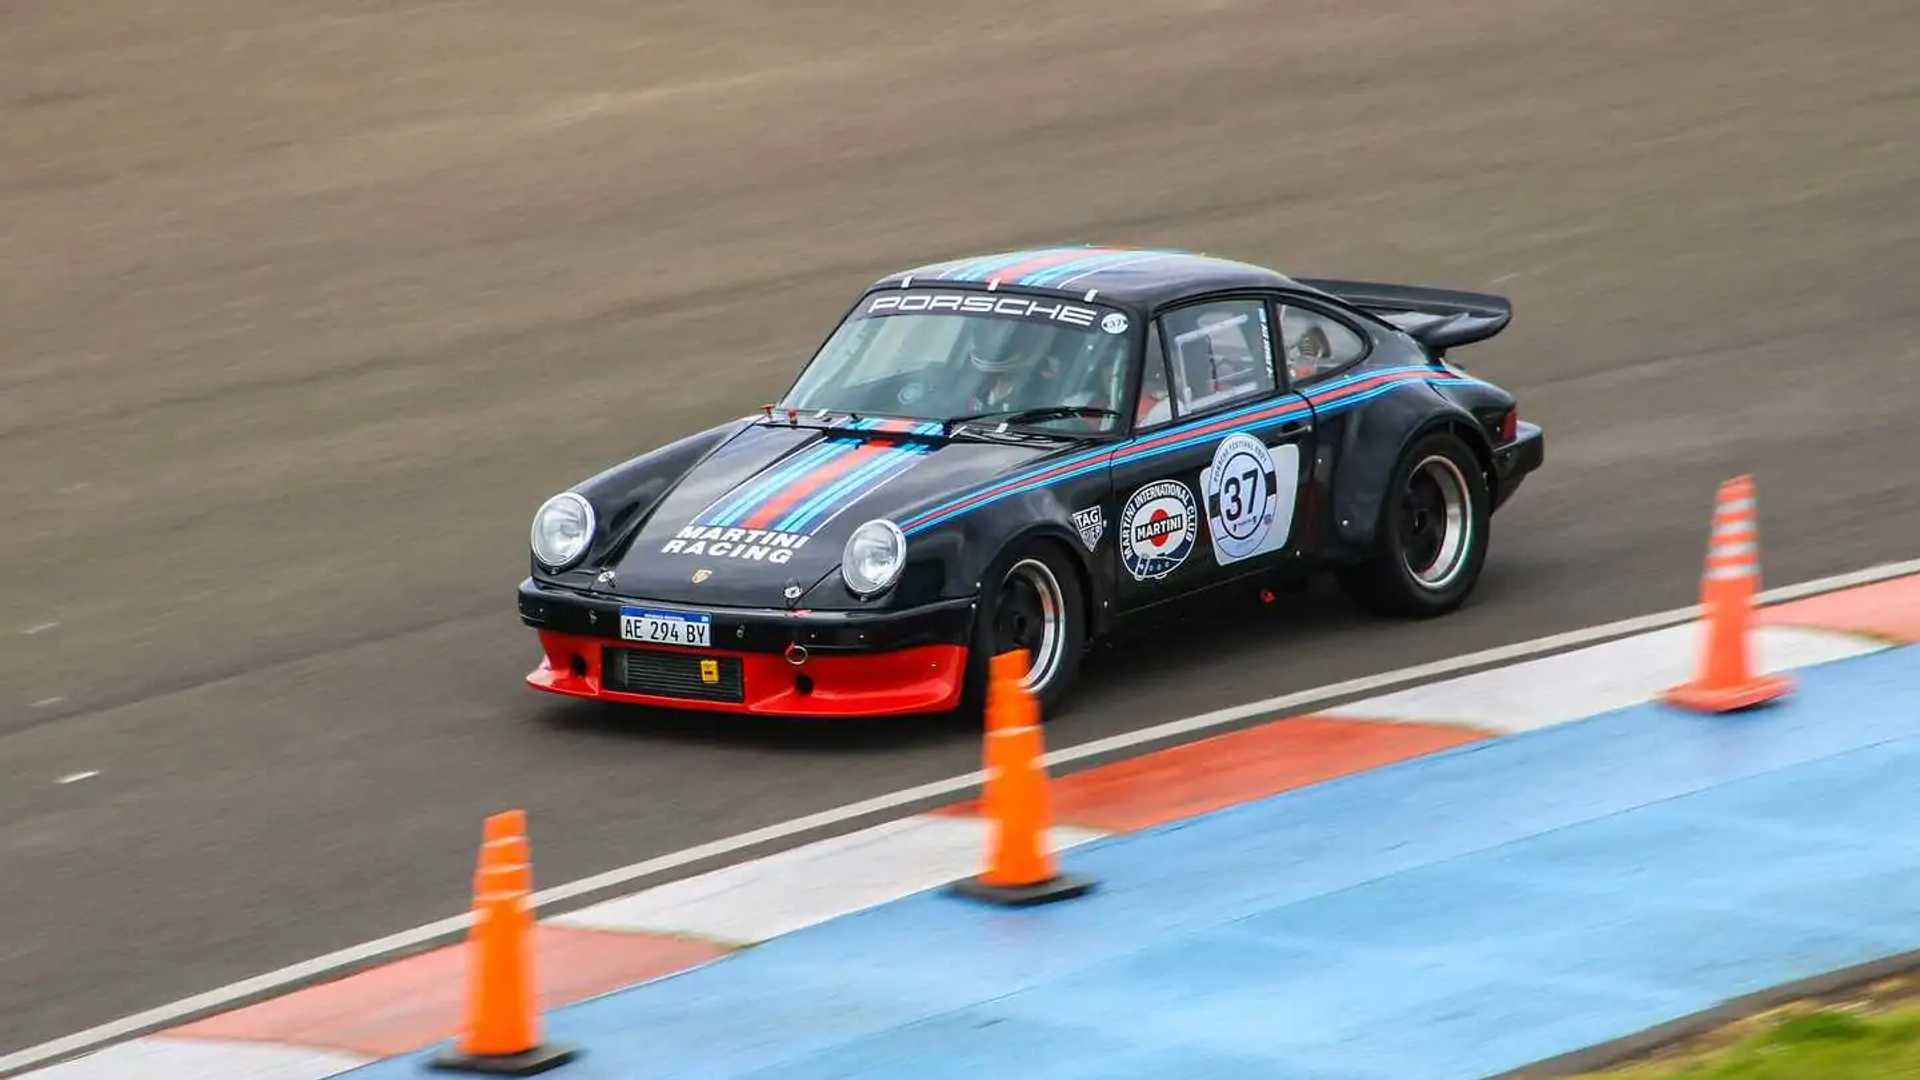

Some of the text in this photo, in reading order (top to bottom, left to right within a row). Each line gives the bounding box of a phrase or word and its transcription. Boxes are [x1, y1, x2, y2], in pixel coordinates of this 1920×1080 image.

[868, 296, 1097, 326] PORSCHE
[1224, 468, 1258, 521] 37
[1074, 510, 1099, 528] TAG
[1122, 503, 1136, 560] MARTINI
[1134, 483, 1190, 507] INTERNATIONAL
[1186, 506, 1196, 543] CLUB
[1137, 515, 1181, 540] MARTINI
[675, 525, 810, 549] MARTINI
[661, 539, 793, 564] RACING
[625, 618, 705, 643] AE 294 BY
